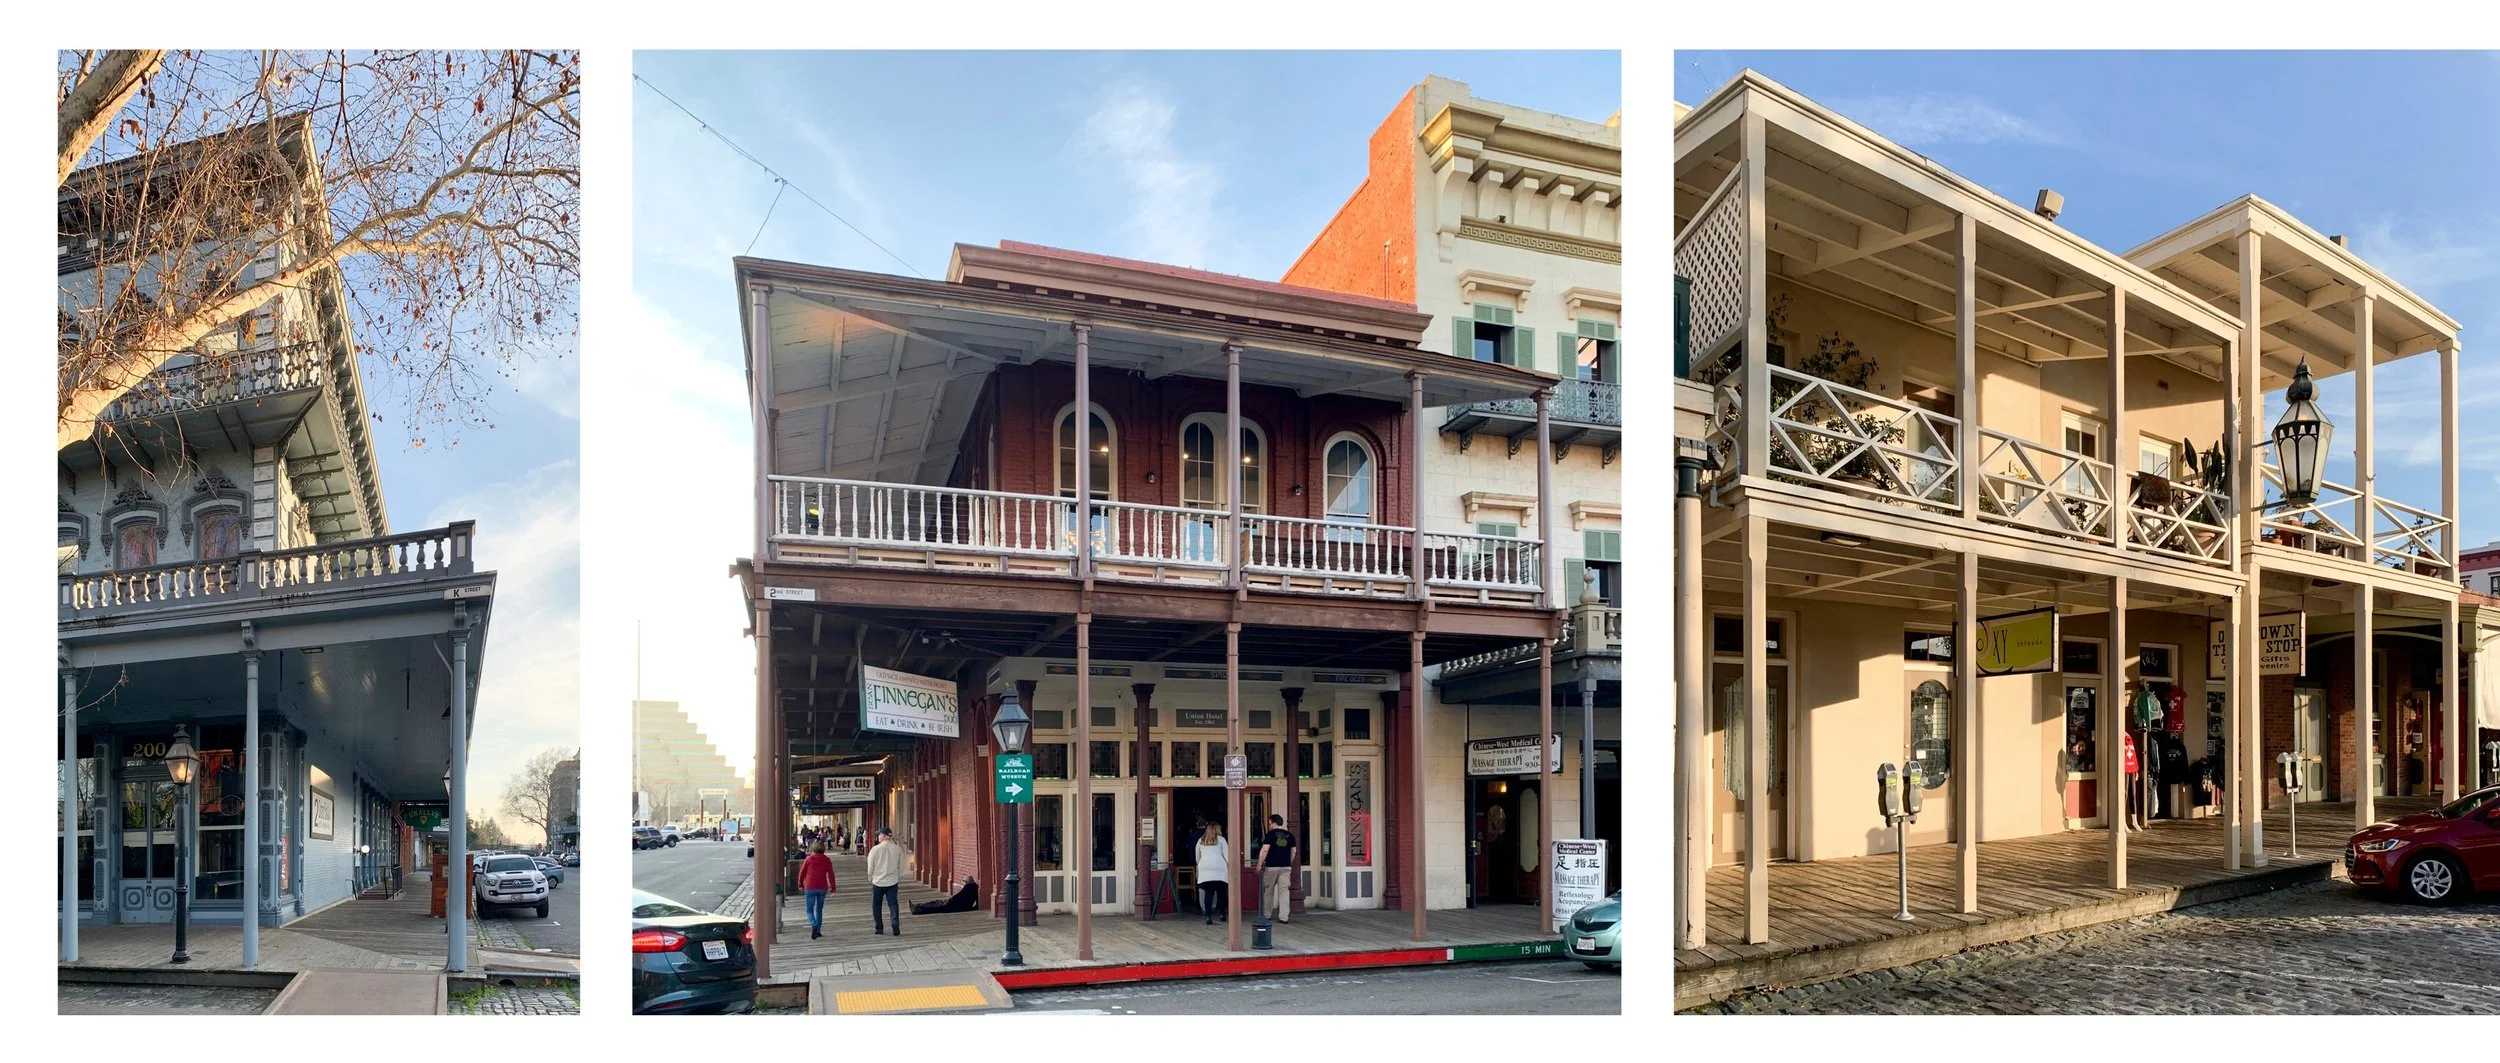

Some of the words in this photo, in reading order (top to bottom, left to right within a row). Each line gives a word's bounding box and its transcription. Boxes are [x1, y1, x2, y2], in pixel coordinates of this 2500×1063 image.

[453, 589, 460, 598] K
[2260, 623, 2296, 640] OWN
[2266, 638, 2300, 654] STOP
[2261, 655, 2290, 663] Gifts
[873, 684, 957, 714] FINNEGAN'S
[875, 716, 888, 726] EAT
[897, 719, 919, 730] DRINK
[929, 723, 935, 732] BE
[937, 724, 953, 733] IRISH
[133, 742, 166, 757] 200
[1510, 738, 1533, 747] Medical
[1472, 757, 1495, 768] MASSAGE
[1497, 755, 1523, 767] THERAPY
[827, 778, 851, 789] River
[854, 778, 872, 789] City
[1350, 764, 1367, 857] FINNEGAN'S
[1555, 855, 1571, 870] 足
[1555, 871, 1576, 885] MASSAGE
[1577, 873, 1600, 886] THERAPY
[1559, 890, 1594, 900] Reflexology
[1521, 946, 1531, 955] 15
[1535, 945, 1551, 954] MIN
